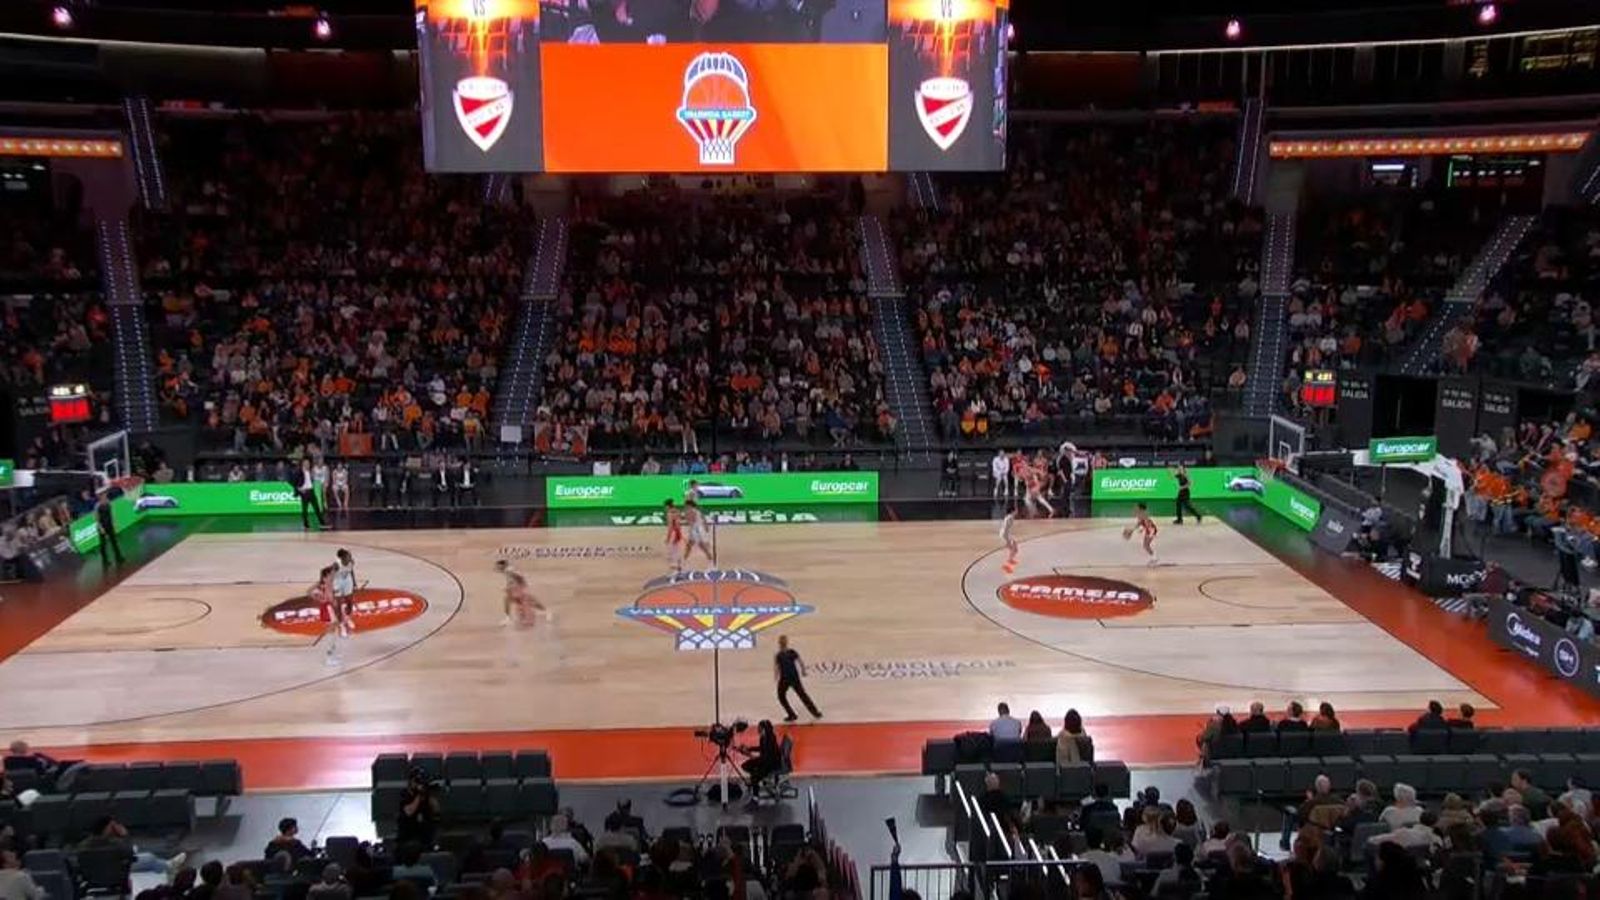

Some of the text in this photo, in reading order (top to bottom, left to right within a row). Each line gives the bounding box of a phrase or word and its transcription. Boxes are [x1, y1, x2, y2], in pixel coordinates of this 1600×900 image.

[1376, 442, 1430, 456] Europcar
[811, 480, 868, 494] Europcar
[1101, 477, 1157, 490] Europcar
[555, 484, 614, 498] Europcar
[629, 605, 801, 616] VALENCIA BASKET
